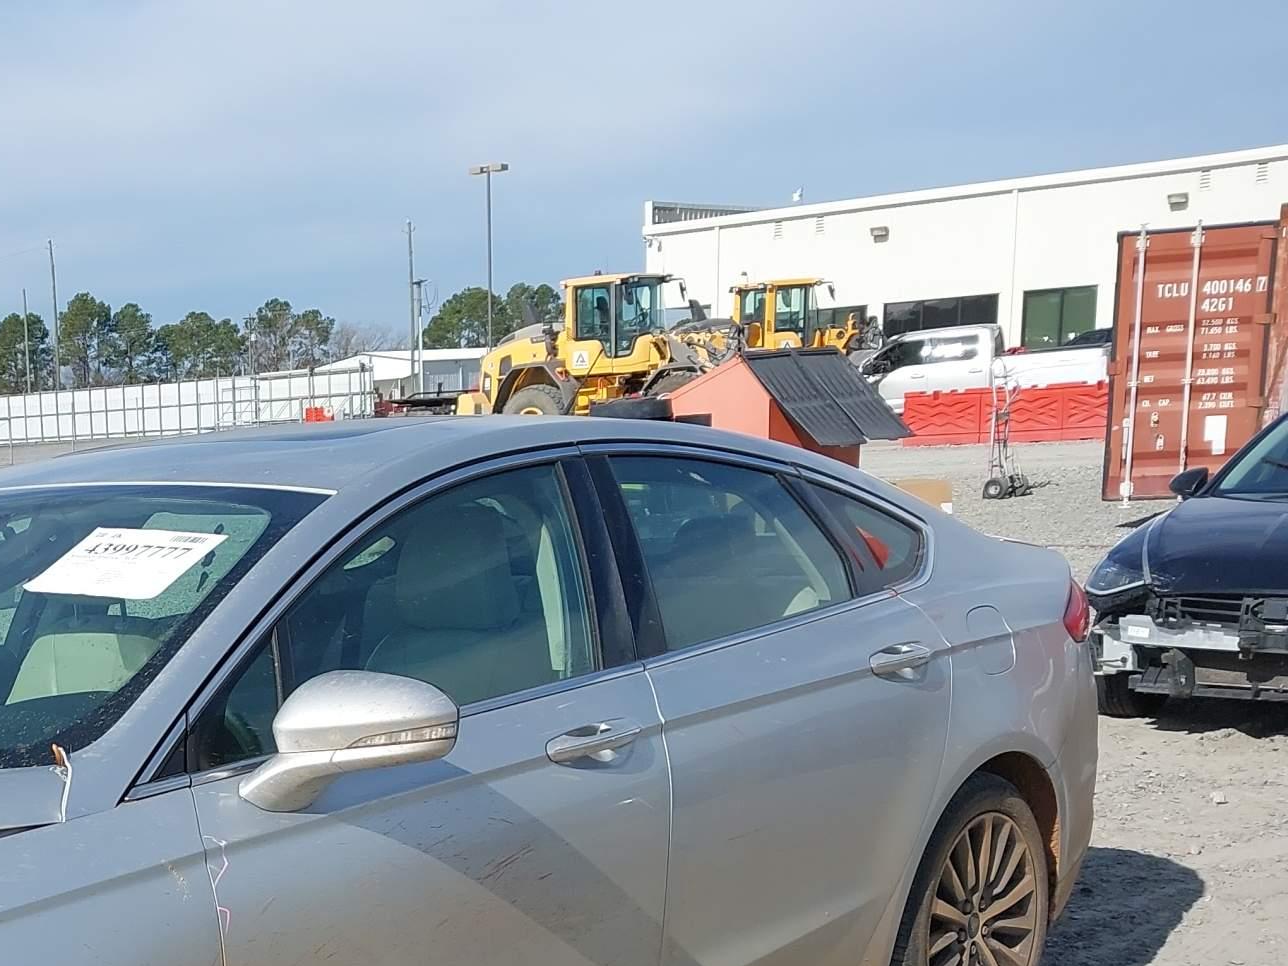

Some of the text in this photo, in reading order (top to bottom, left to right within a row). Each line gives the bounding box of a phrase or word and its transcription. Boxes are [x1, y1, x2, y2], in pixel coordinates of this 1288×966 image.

[1157, 277, 1268, 298] TCLU 400146 7
[1201, 297, 1234, 312] 42G1
[84, 542, 193, 560] 43997777
